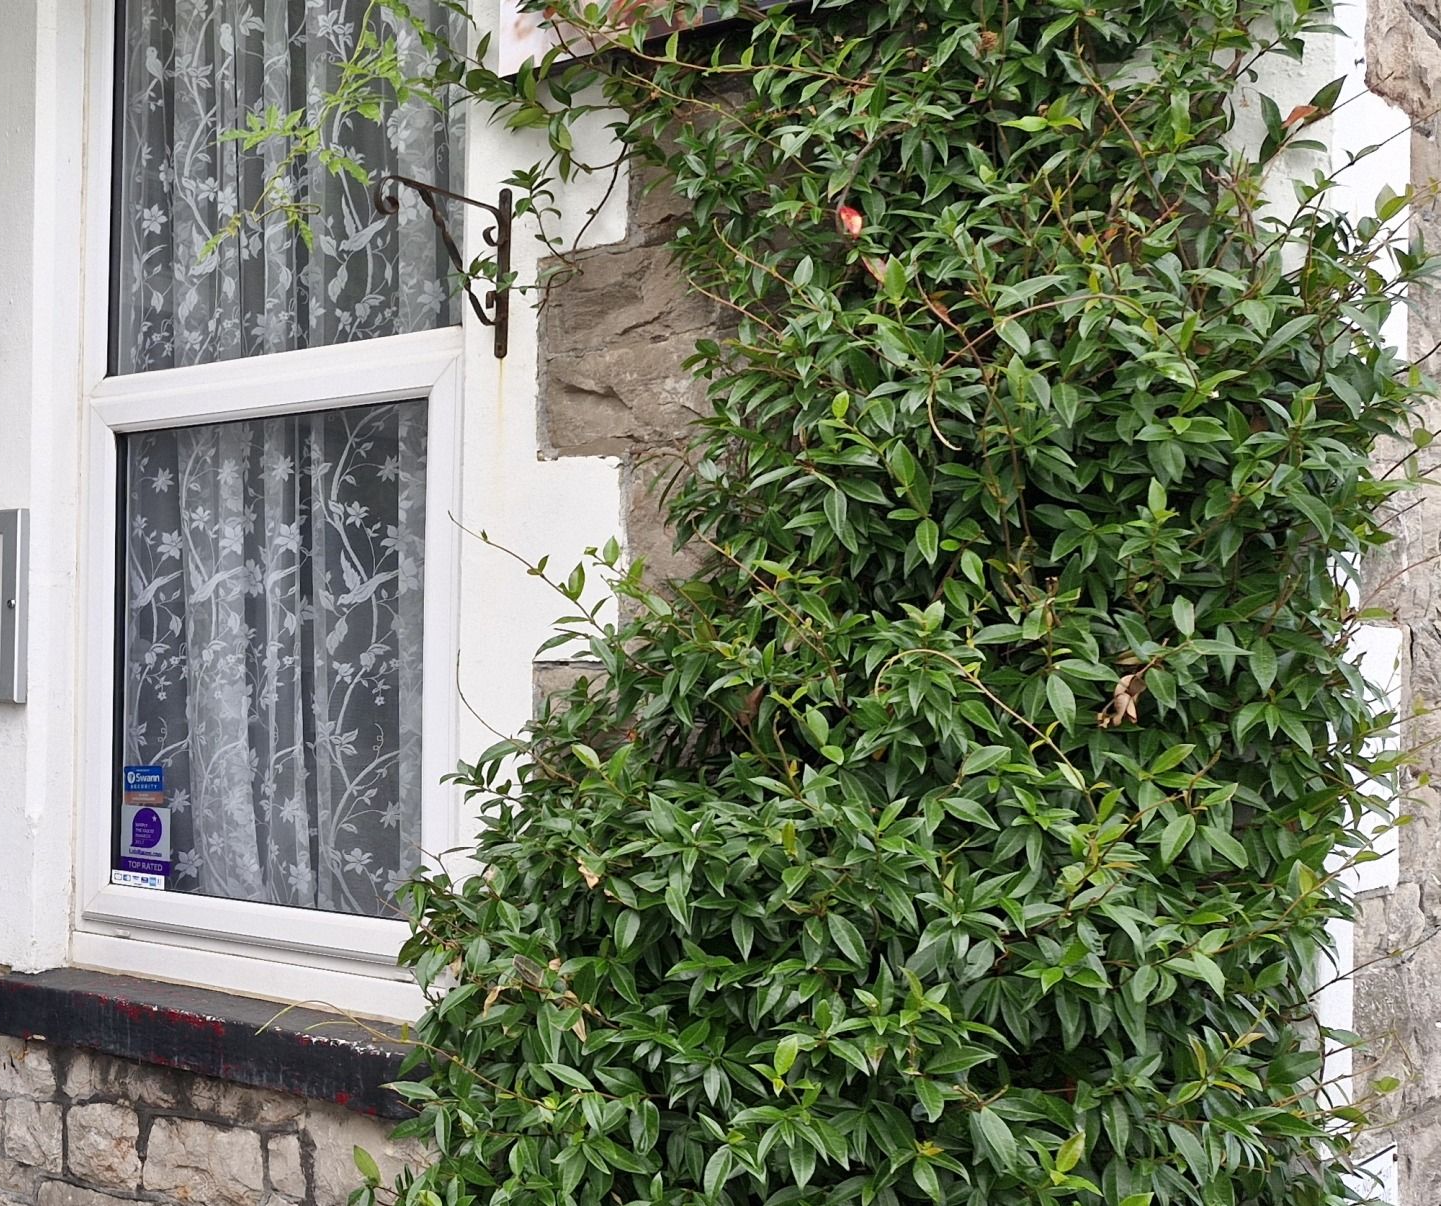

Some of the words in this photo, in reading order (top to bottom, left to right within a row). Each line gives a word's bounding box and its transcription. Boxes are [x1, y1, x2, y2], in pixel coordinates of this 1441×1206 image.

[135, 773, 160, 782] Swann
[127, 860, 141, 869] TOP
[141, 862, 163, 872] RATED
